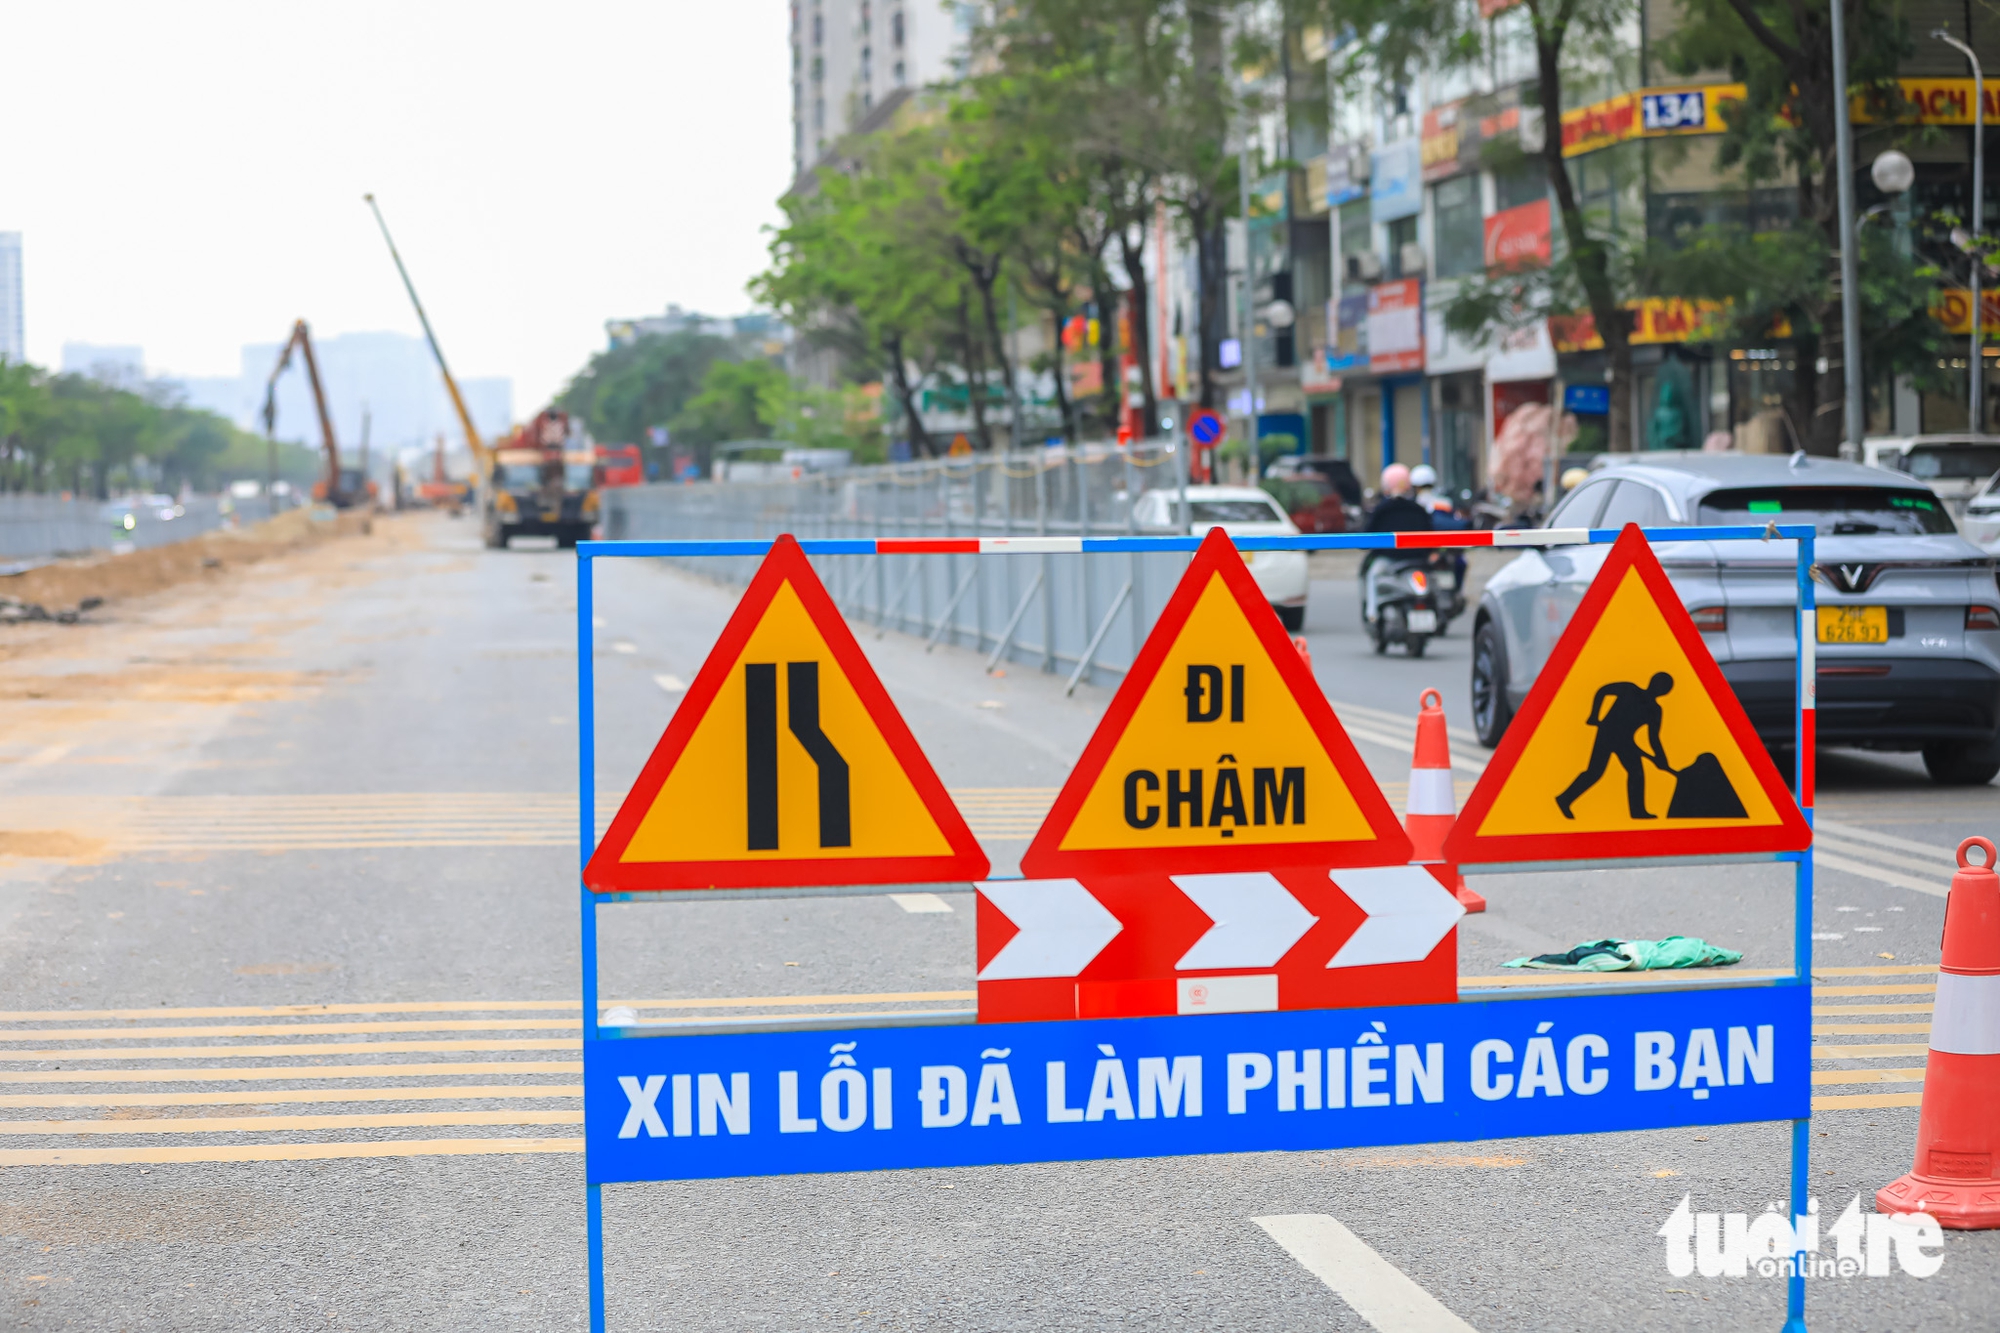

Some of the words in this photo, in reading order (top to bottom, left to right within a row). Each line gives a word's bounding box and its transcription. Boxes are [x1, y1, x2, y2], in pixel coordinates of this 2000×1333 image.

[1644, 93, 1702, 128] 134
[1184, 664, 1245, 723] ĐI
[1123, 753, 1306, 838] CHẬM
[617, 1072, 751, 1139] XIN
[778, 1041, 893, 1133] LỖI
[917, 1047, 1022, 1128] ĐÃ
[1046, 1043, 1203, 1123] LÀM
[1227, 1021, 1444, 1115] PHIỀN
[1470, 1021, 1609, 1101] CÁC
[1634, 1024, 1774, 1100] BẠN
